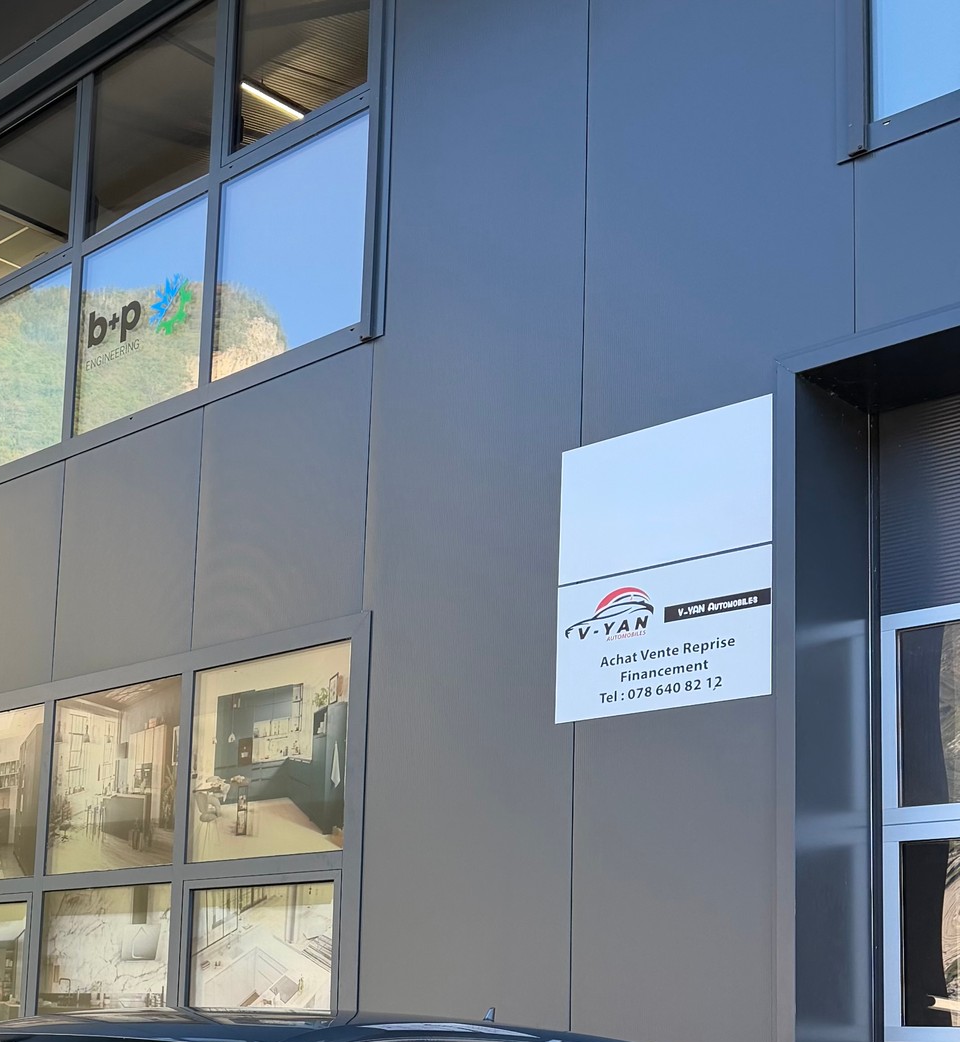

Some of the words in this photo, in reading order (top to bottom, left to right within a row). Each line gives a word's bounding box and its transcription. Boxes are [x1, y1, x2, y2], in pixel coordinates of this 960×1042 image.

[87, 300, 141, 348] b+p
[85, 339, 140, 371] ENGINEERING
[678, 603, 705, 616] V-YAN
[578, 615, 649, 640] V-YAN
[607, 630, 646, 642] AUTOMOBILES
[600, 652, 637, 668] Achat
[640, 646, 679, 661] Vente
[683, 637, 736, 654] Reprise
[620, 660, 709, 682] Financement
[628, 686, 652, 699] 078
[656, 682, 681, 695] 640
[684, 679, 701, 691] 82
[706, 676, 722, 689] 12
